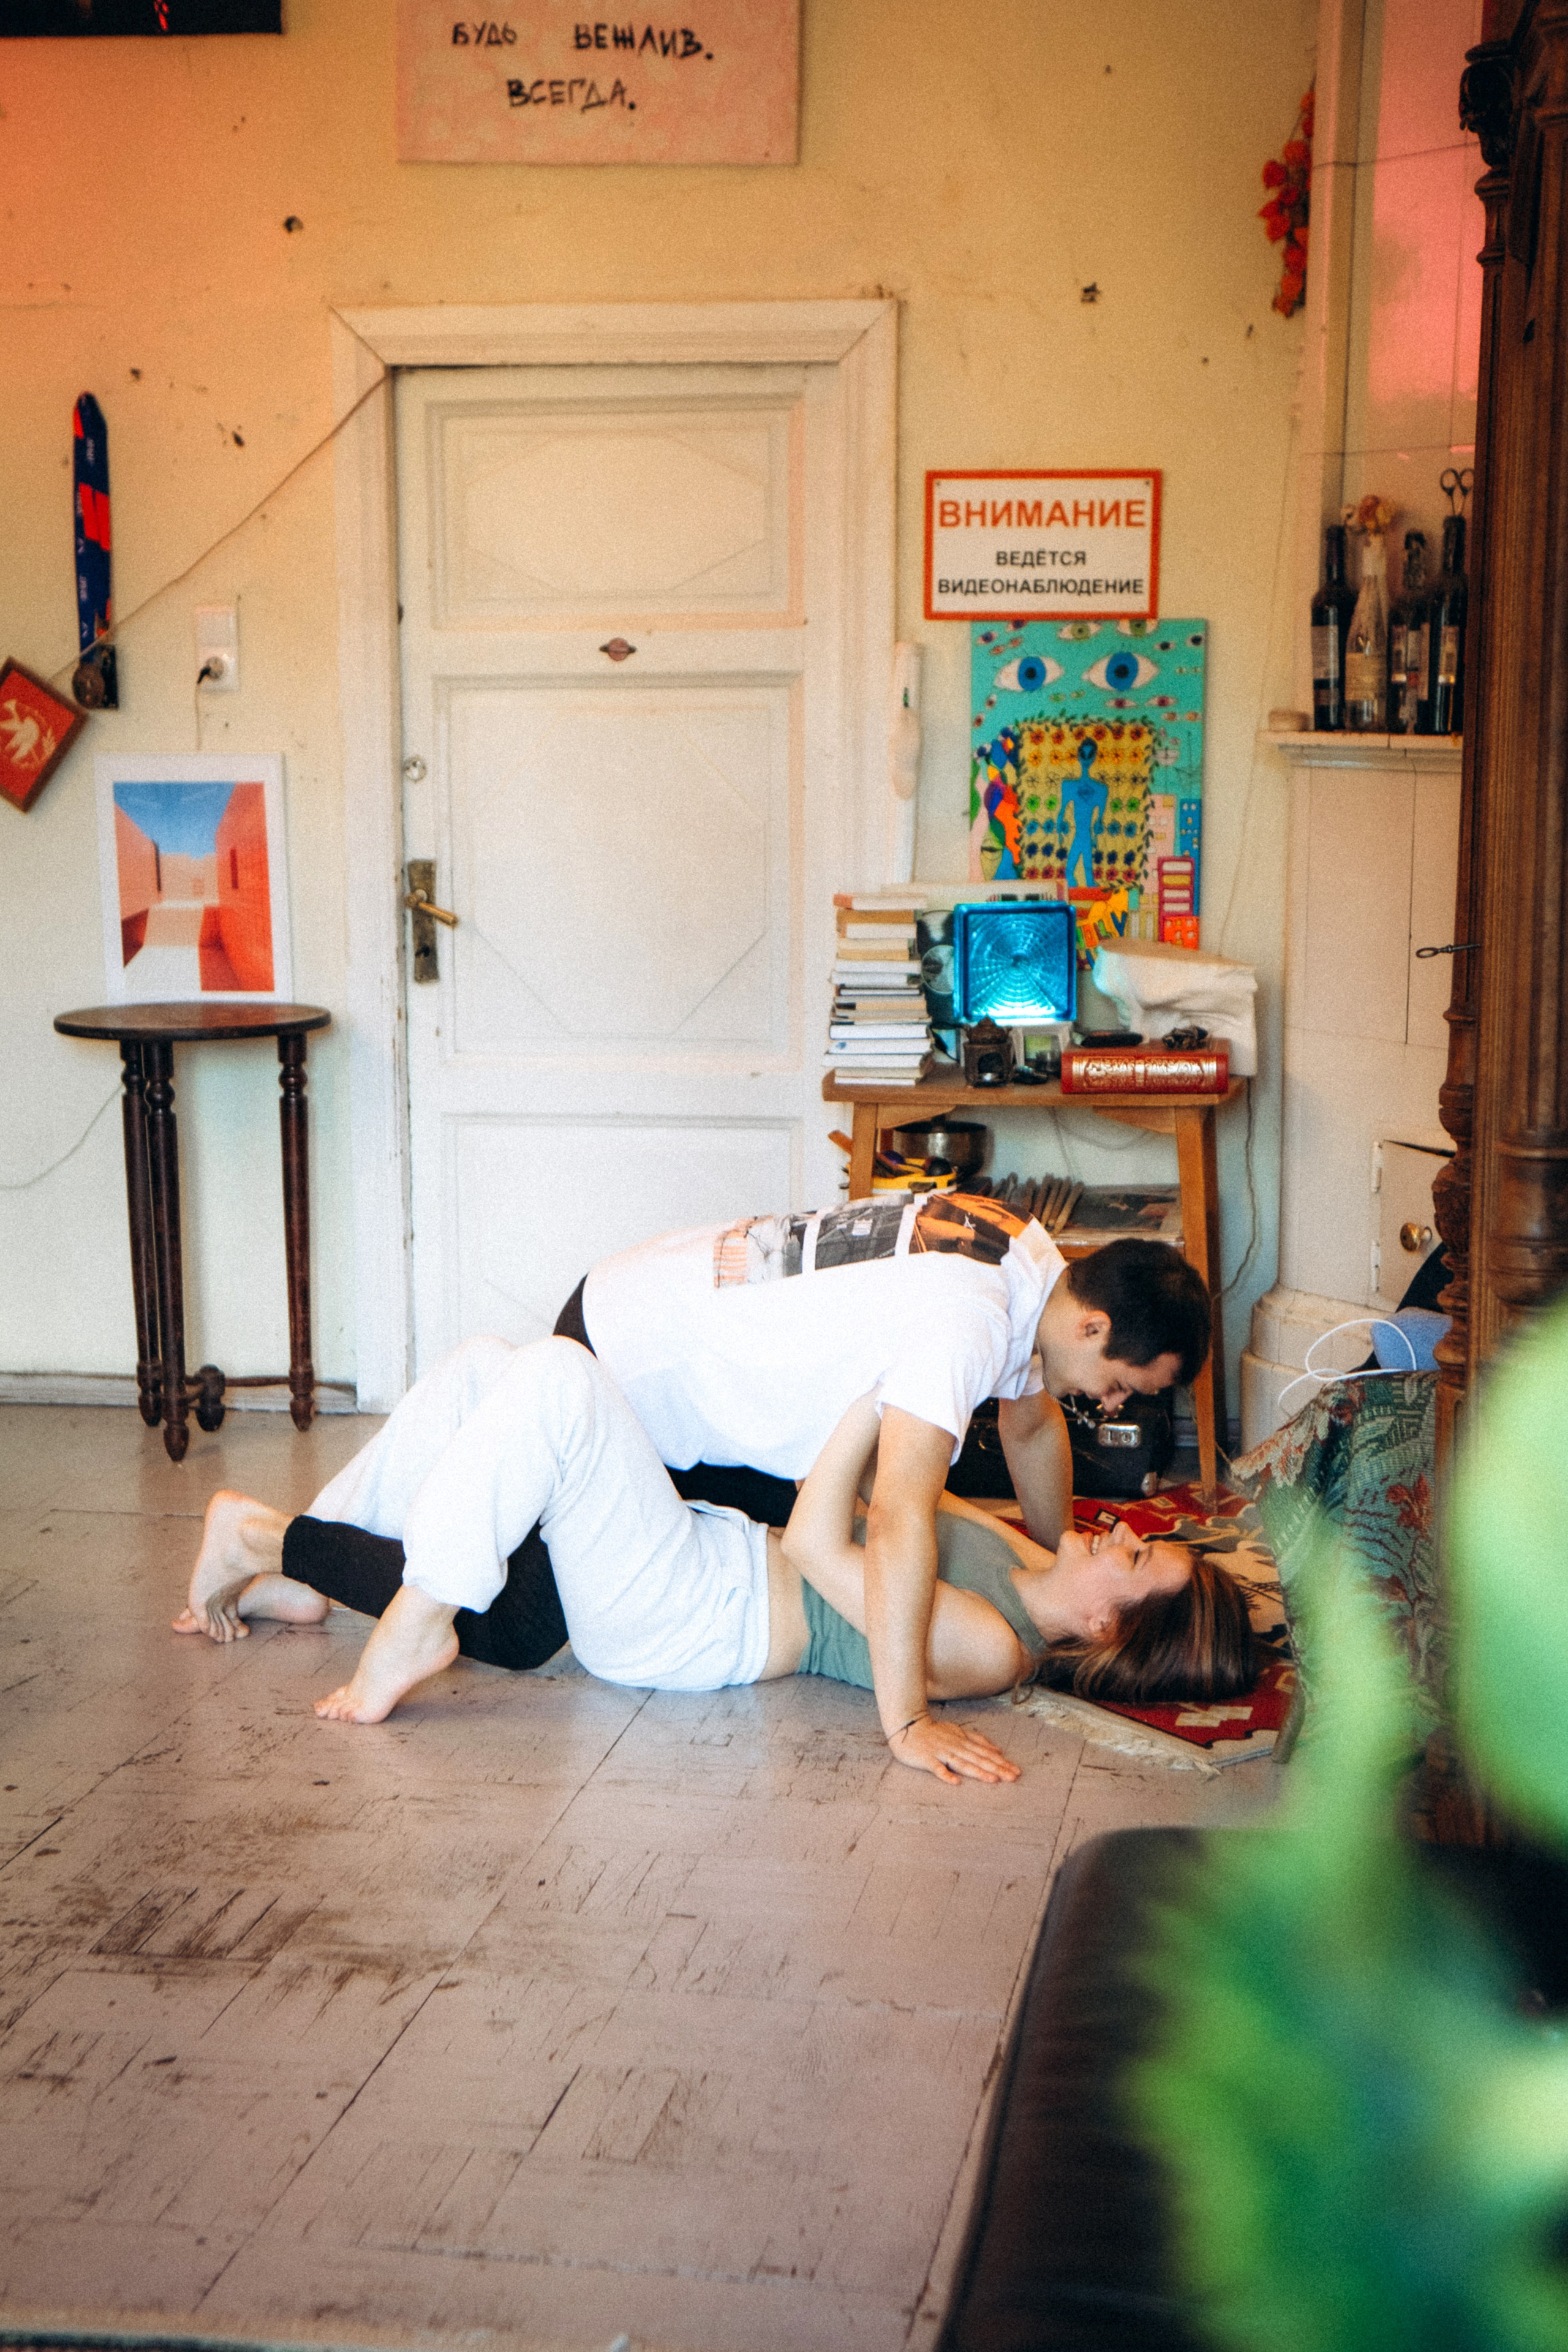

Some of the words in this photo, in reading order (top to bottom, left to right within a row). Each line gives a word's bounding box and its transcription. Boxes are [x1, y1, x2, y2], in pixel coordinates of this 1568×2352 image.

[452, 21, 518, 49] БУДЬ
[574, 23, 714, 61] ВЕЖЛИВ.
[507, 78, 636, 115] ВСЕГДА.
[938, 499, 1147, 528] ВНИМАНИЕ
[995, 548, 1087, 568] ВЕДЁТСЯ
[938, 578, 1144, 597] ВИДЕОНАБЛЮДЕНИЕ
